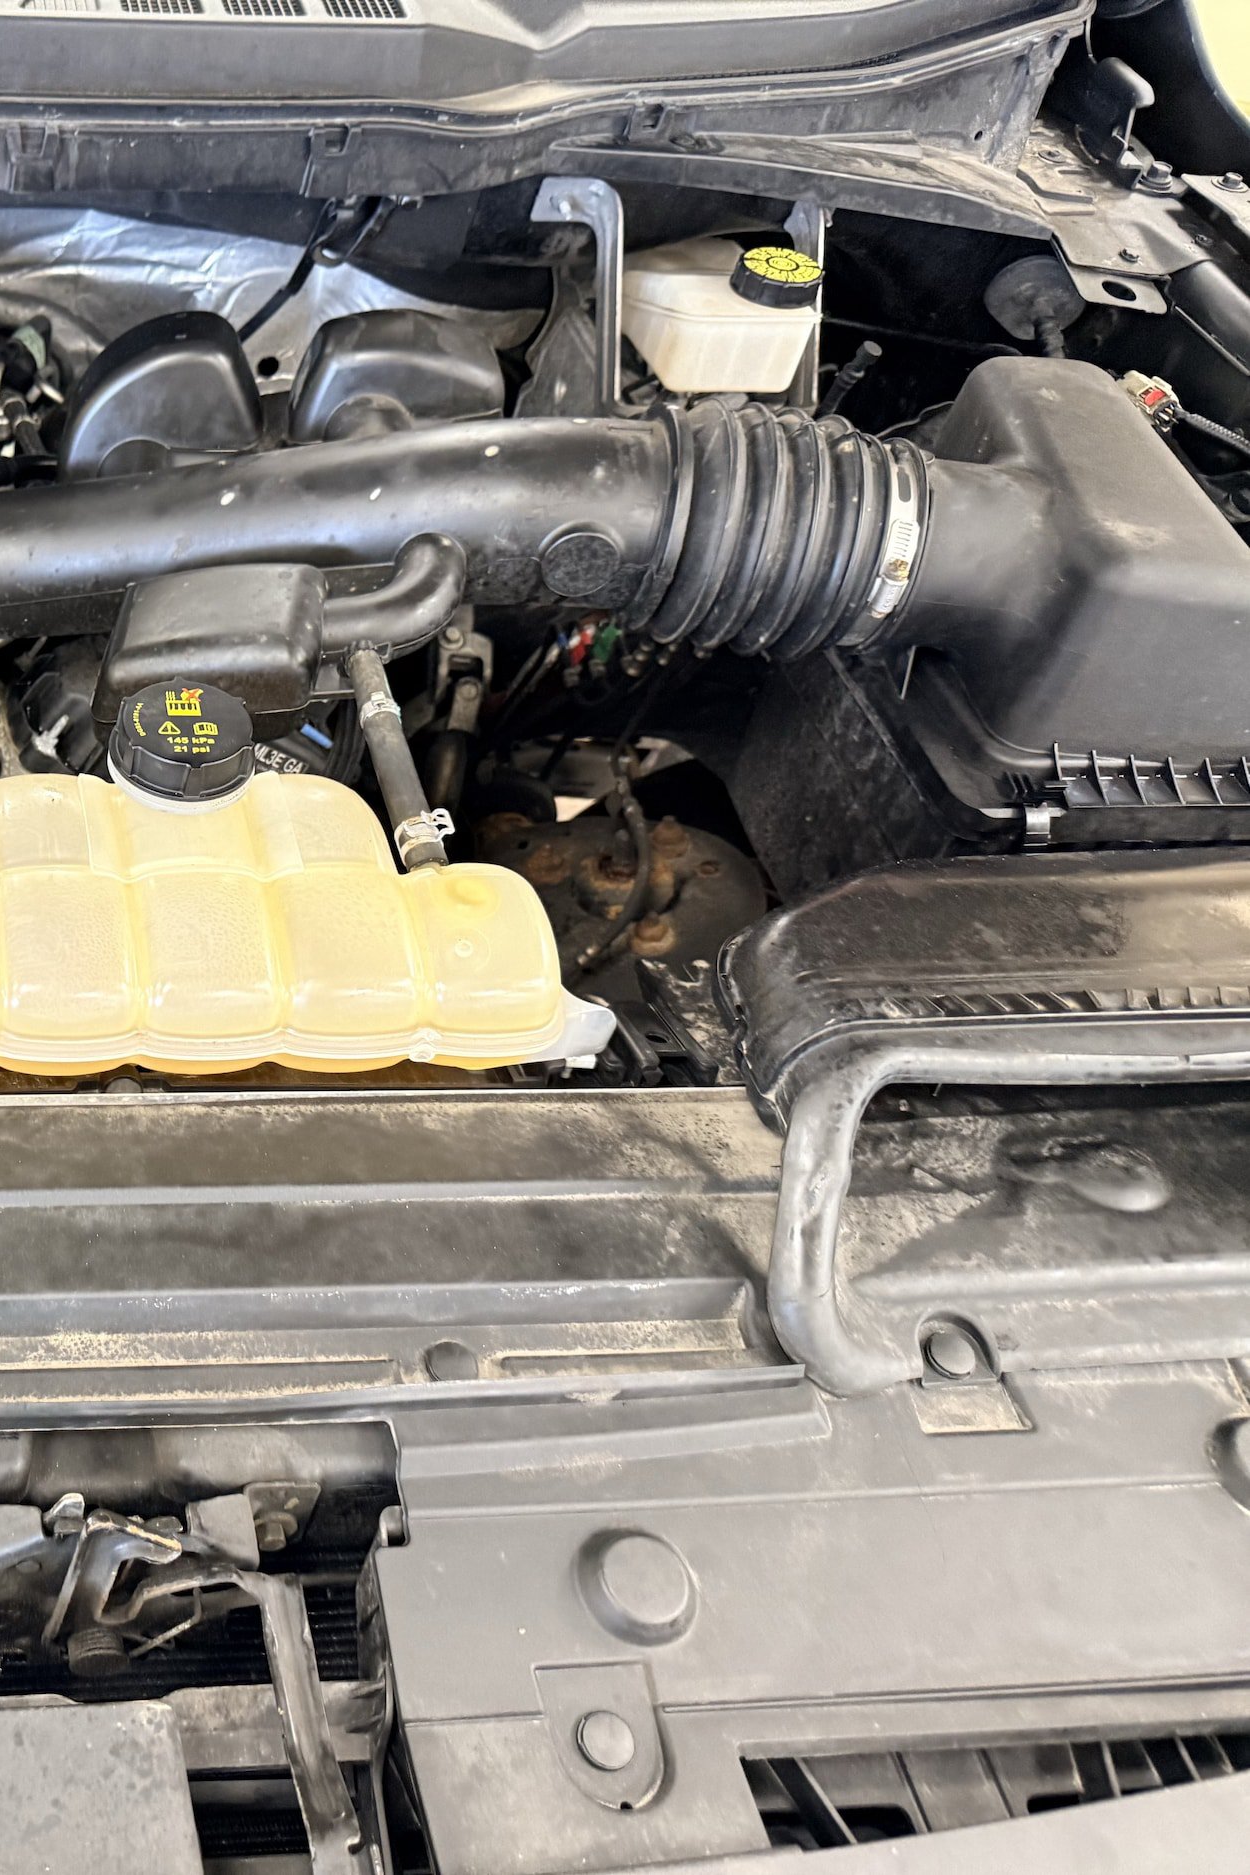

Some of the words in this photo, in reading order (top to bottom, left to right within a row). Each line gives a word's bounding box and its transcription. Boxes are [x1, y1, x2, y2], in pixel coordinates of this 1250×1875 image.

[167, 736, 189, 744] 145
[192, 736, 215, 744] kPa
[173, 745, 188, 753] 21
[192, 745, 211, 754] psi
